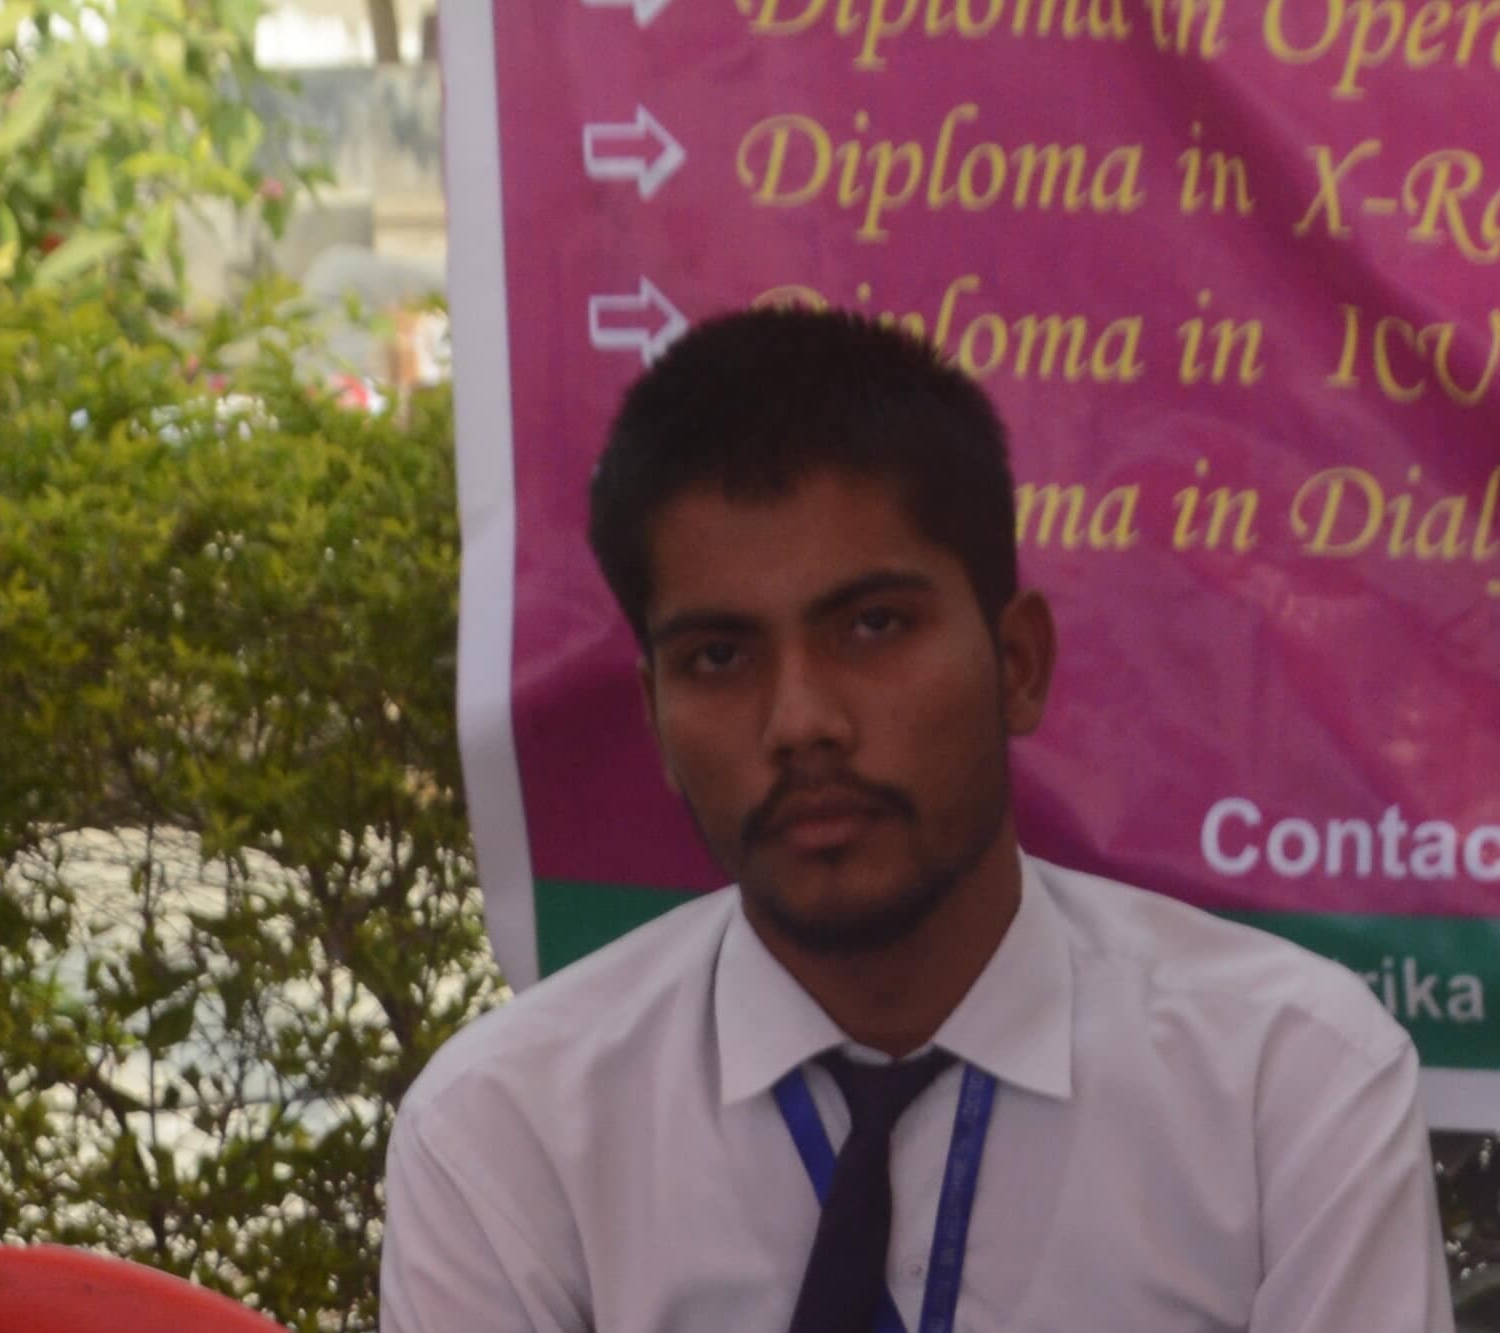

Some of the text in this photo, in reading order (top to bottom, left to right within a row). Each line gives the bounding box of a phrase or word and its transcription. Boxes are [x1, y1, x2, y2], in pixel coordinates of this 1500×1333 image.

[736, 103, 1145, 241] Diploma
[1177, 121, 1254, 215] in
[1177, 289, 1263, 384] in
[1171, 458, 1260, 553] in
